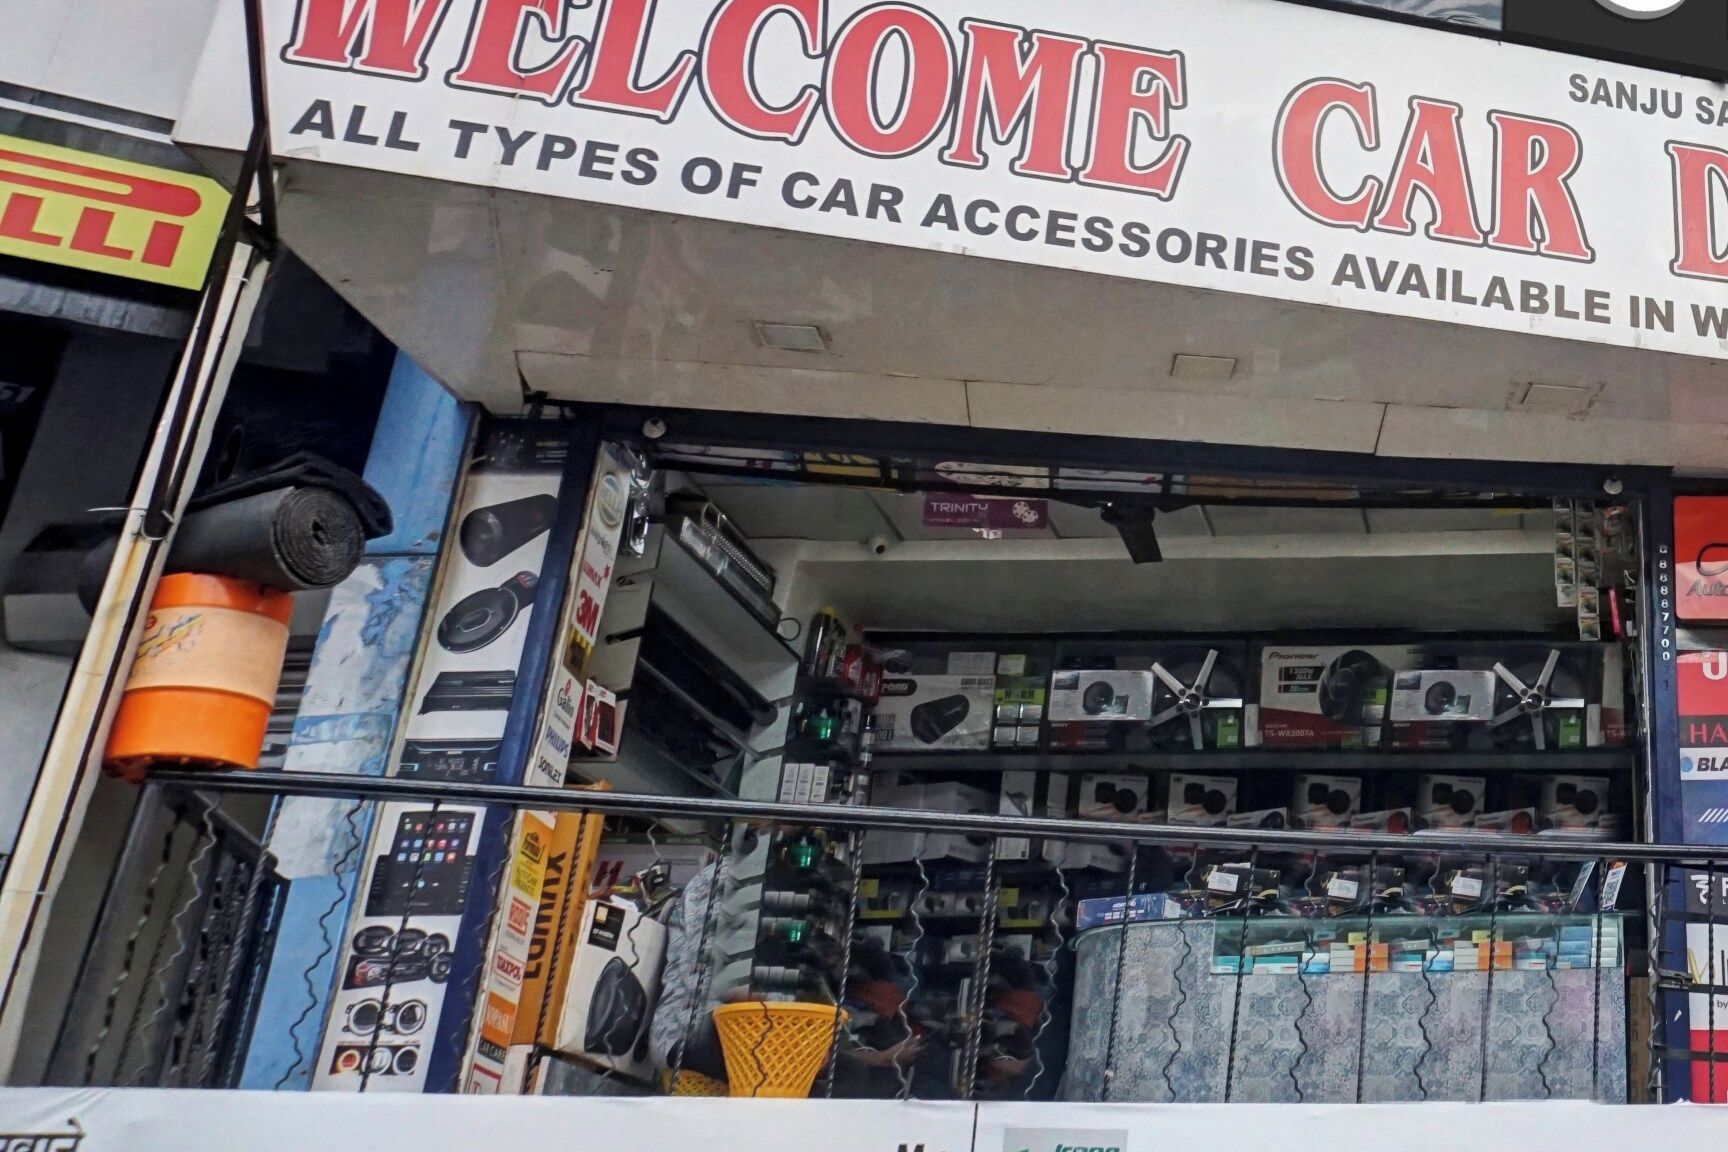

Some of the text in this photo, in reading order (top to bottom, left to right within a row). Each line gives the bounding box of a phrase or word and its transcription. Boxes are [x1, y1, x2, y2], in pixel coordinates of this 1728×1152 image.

[1568, 74, 1684, 119] SANJU
[1272, 77, 1596, 264] CAR
[289, 99, 420, 152] ALL
[448, 119, 659, 186] TYPES
[680, 157, 763, 200] OF
[781, 172, 904, 224] CAR
[920, 194, 1315, 282] ACCESSORIES
[1331, 253, 1612, 324] AVAILABLE
[1630, 295, 1675, 333] IN
[930, 502, 989, 513] TRINITY
[1717, 999, 1728, 1009] by
